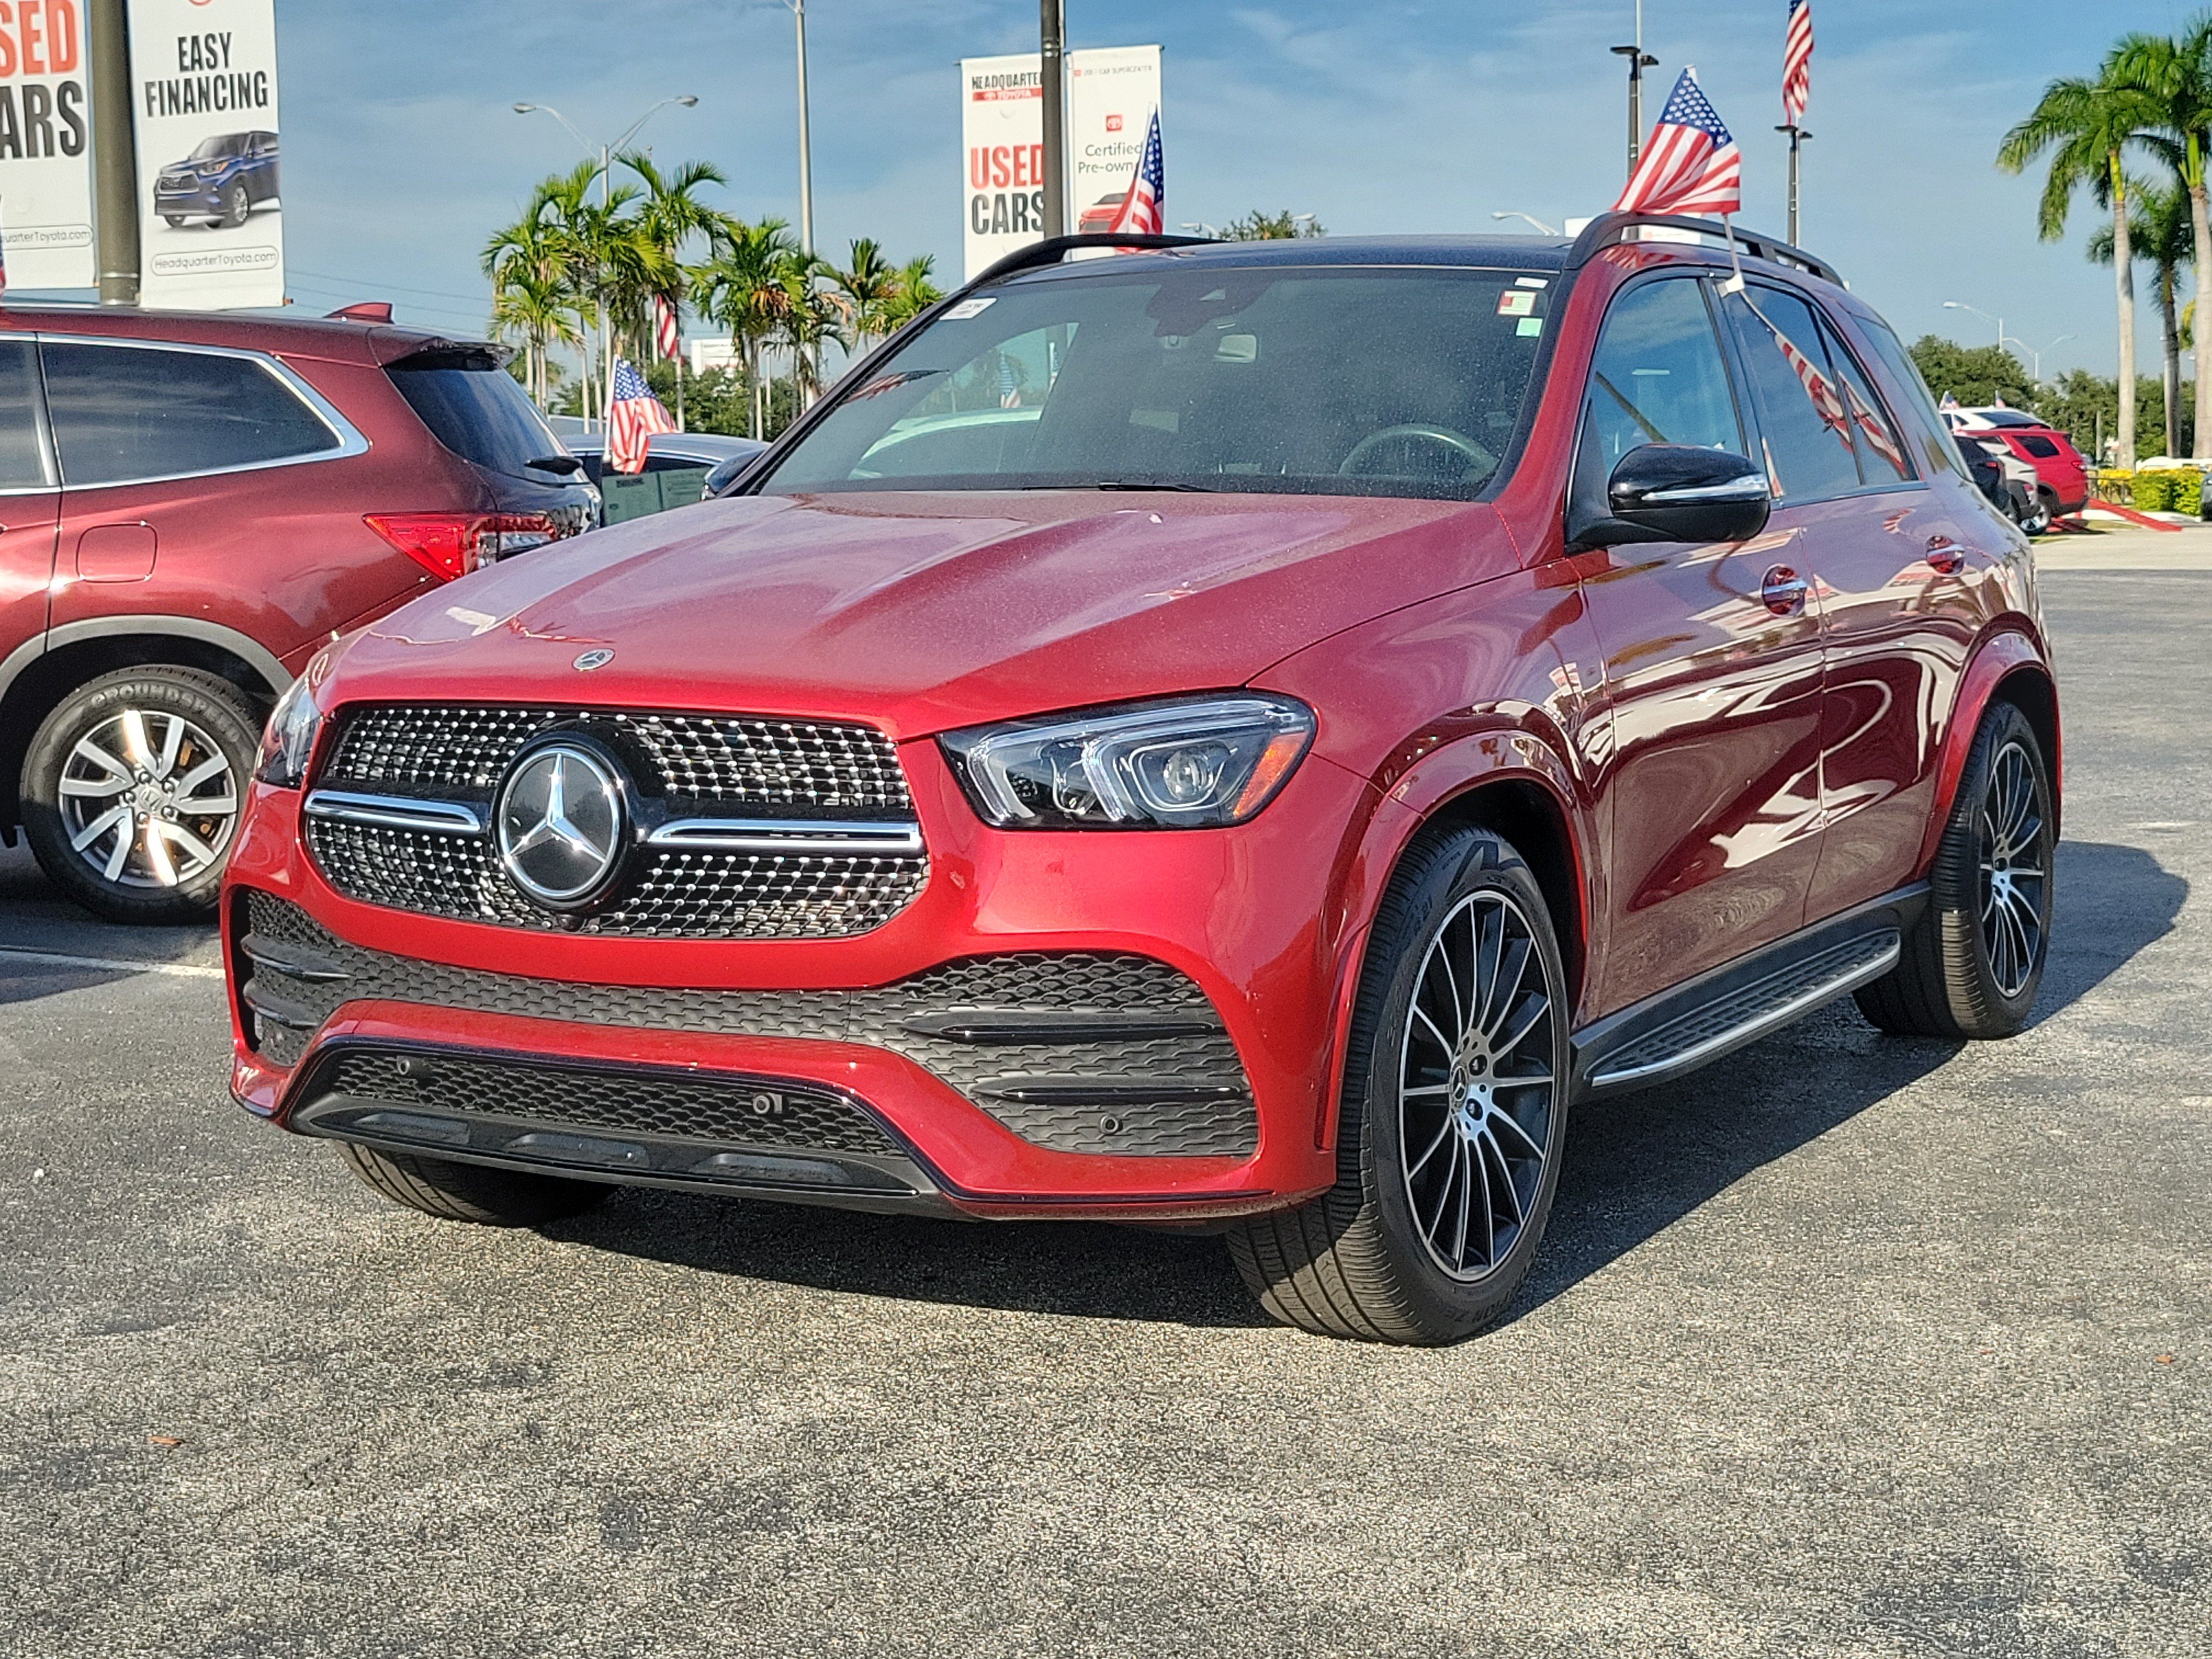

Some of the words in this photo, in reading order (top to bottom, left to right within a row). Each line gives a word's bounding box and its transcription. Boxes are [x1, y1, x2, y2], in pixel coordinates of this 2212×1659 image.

[177, 32, 232, 72] EASY
[145, 70, 268, 117] FINANCING
[972, 72, 1043, 90] HEADQUARTE
[1085, 141, 1143, 157] Certified
[970, 144, 1044, 190] USED
[1078, 161, 1136, 174] Pre-own
[972, 190, 1044, 235] CARS
[154, 252, 276, 269] HeadquarterToyota.com
